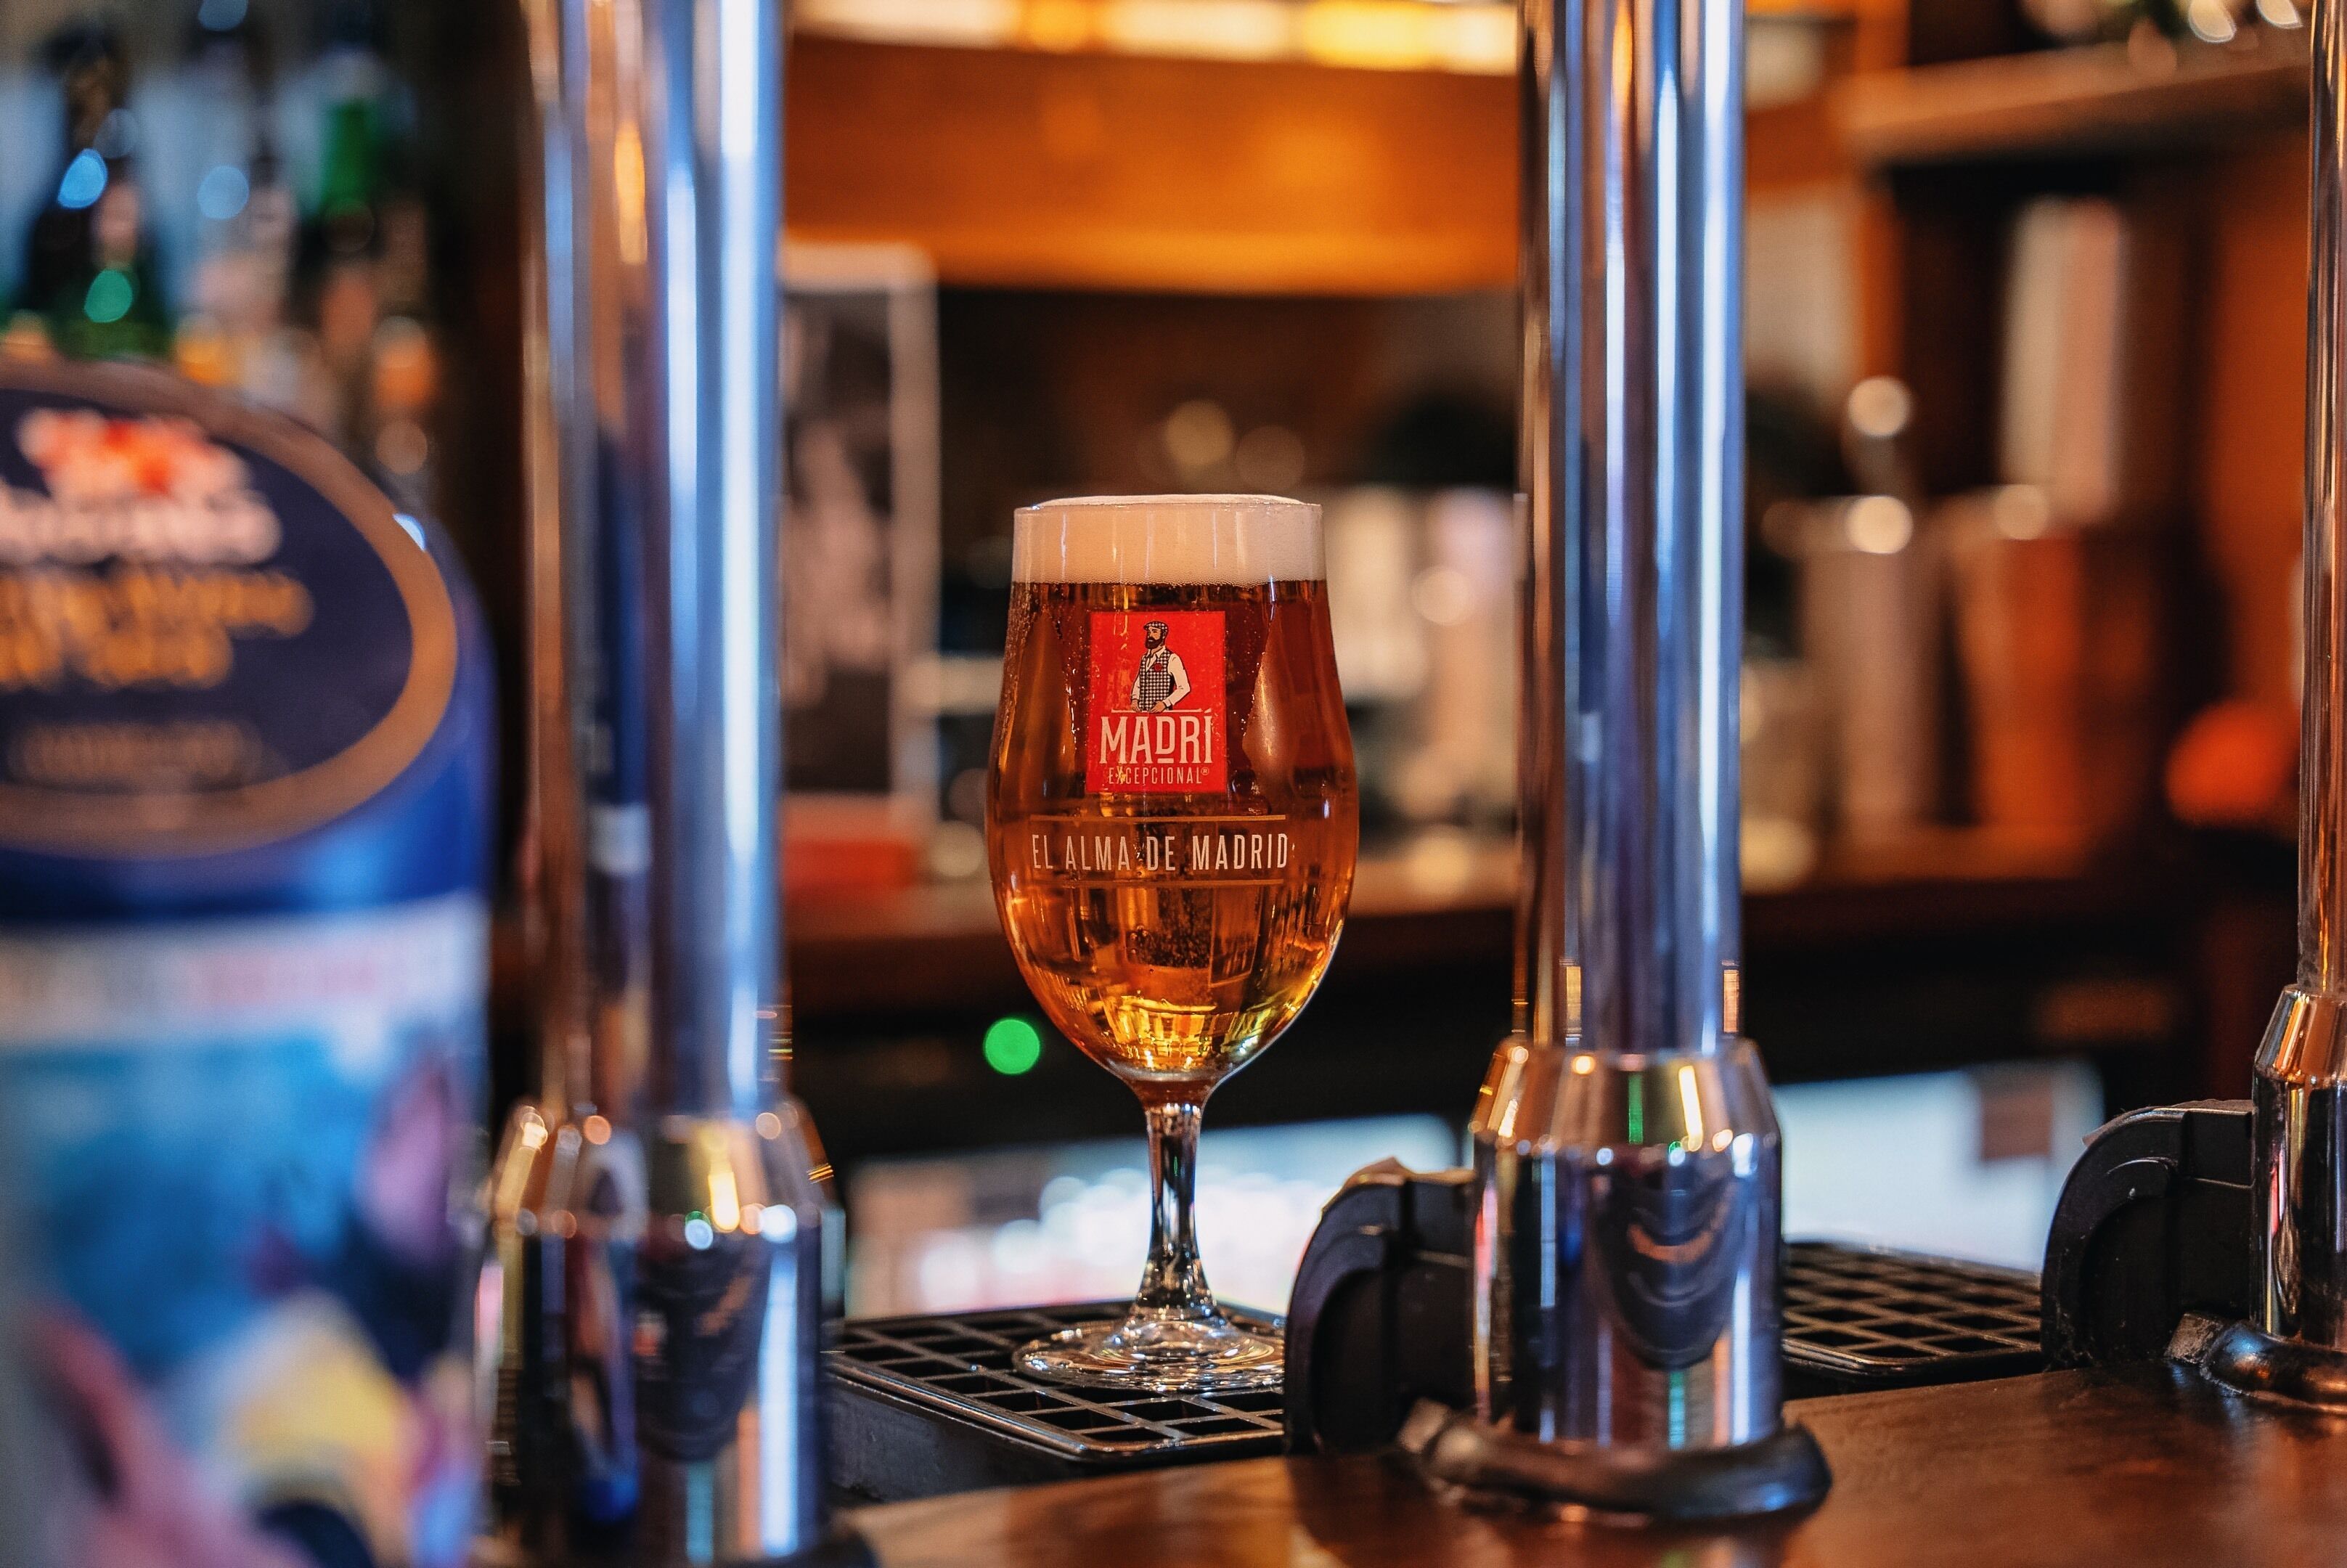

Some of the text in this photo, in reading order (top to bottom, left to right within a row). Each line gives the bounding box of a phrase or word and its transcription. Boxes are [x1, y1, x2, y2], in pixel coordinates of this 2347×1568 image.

[1099, 709, 1212, 764] MADRÍ
[1032, 833, 1288, 871] EL ALMA DE MADRID
